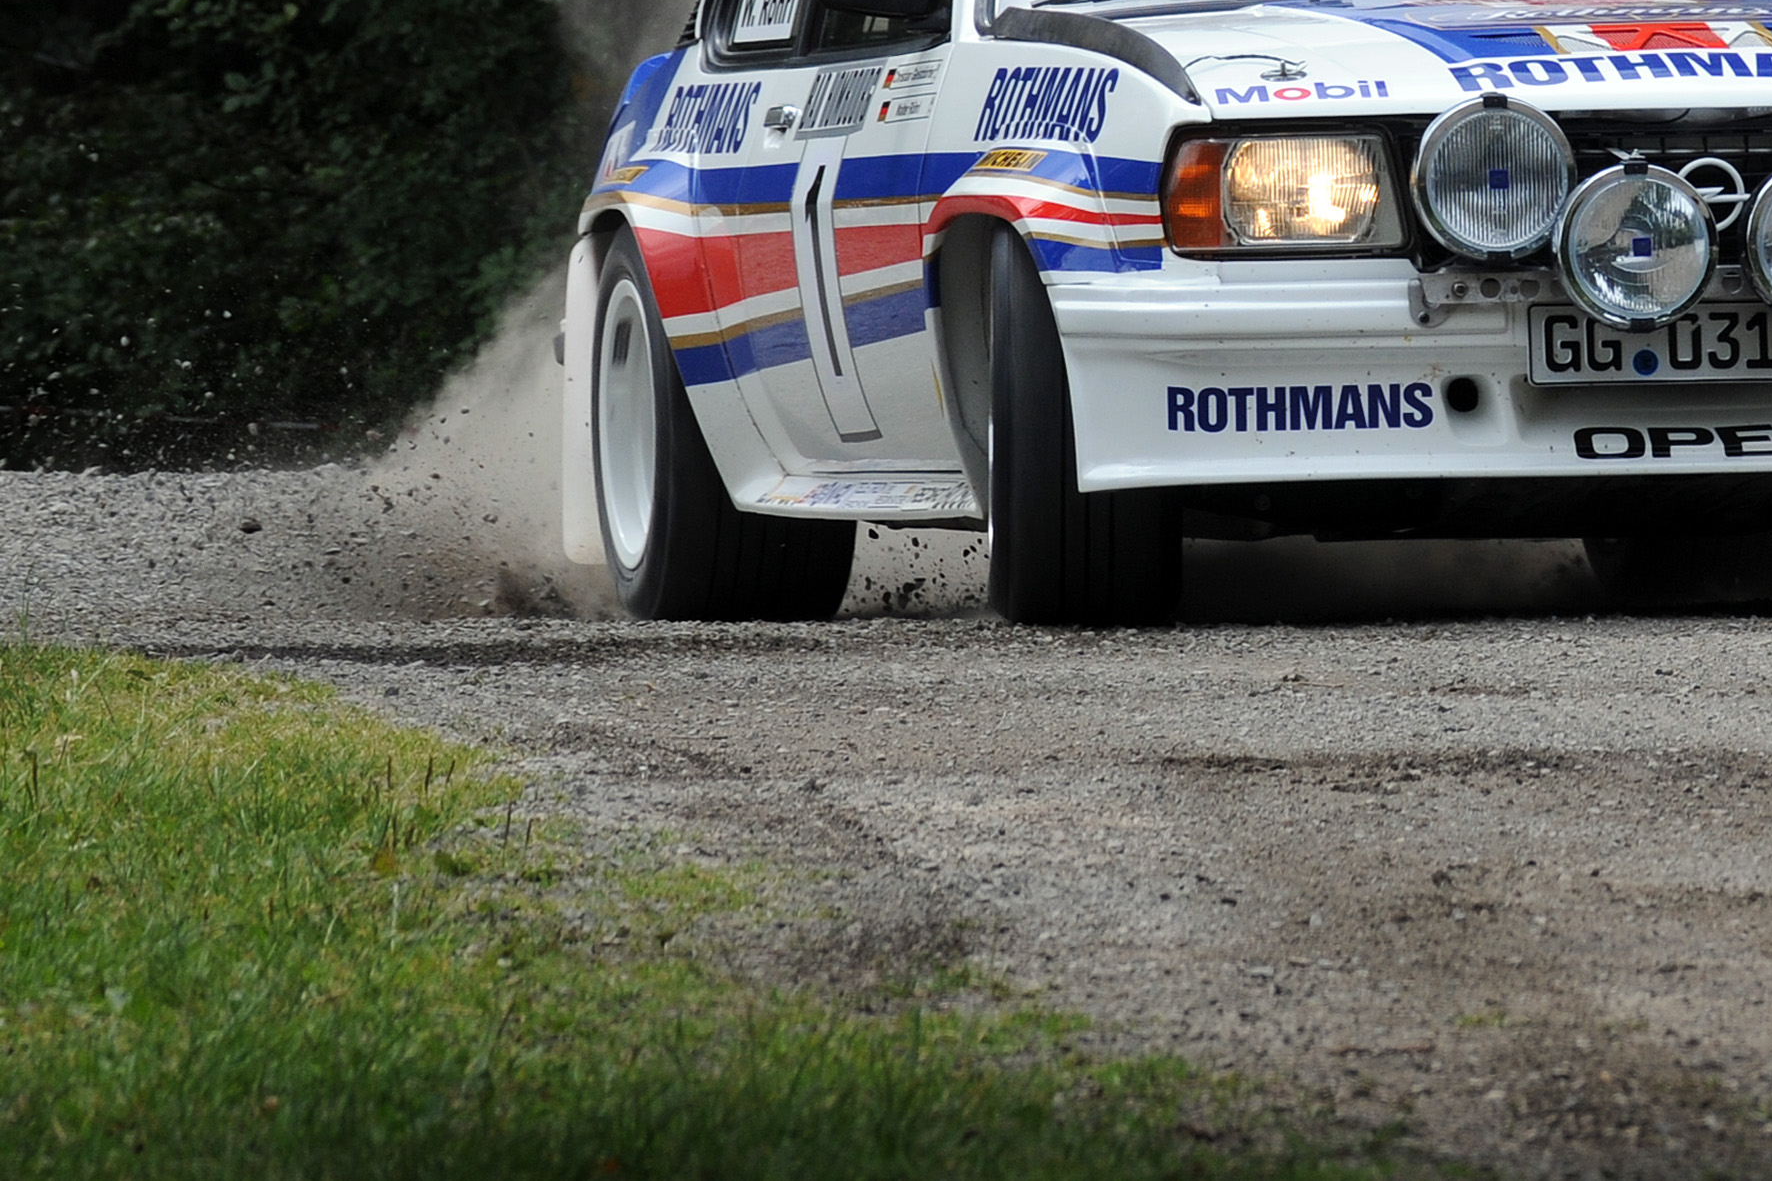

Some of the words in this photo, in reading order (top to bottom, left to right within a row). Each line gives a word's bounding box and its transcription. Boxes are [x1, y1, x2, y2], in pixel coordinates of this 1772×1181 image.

[649, 81, 762, 154] ROTHMANS
[973, 67, 1120, 143] ROTHMANS
[1215, 80, 1389, 105] Mobil
[805, 165, 843, 377] 1
[1544, 313, 1623, 372] GG
[1167, 382, 1434, 432] ROTHMANS
